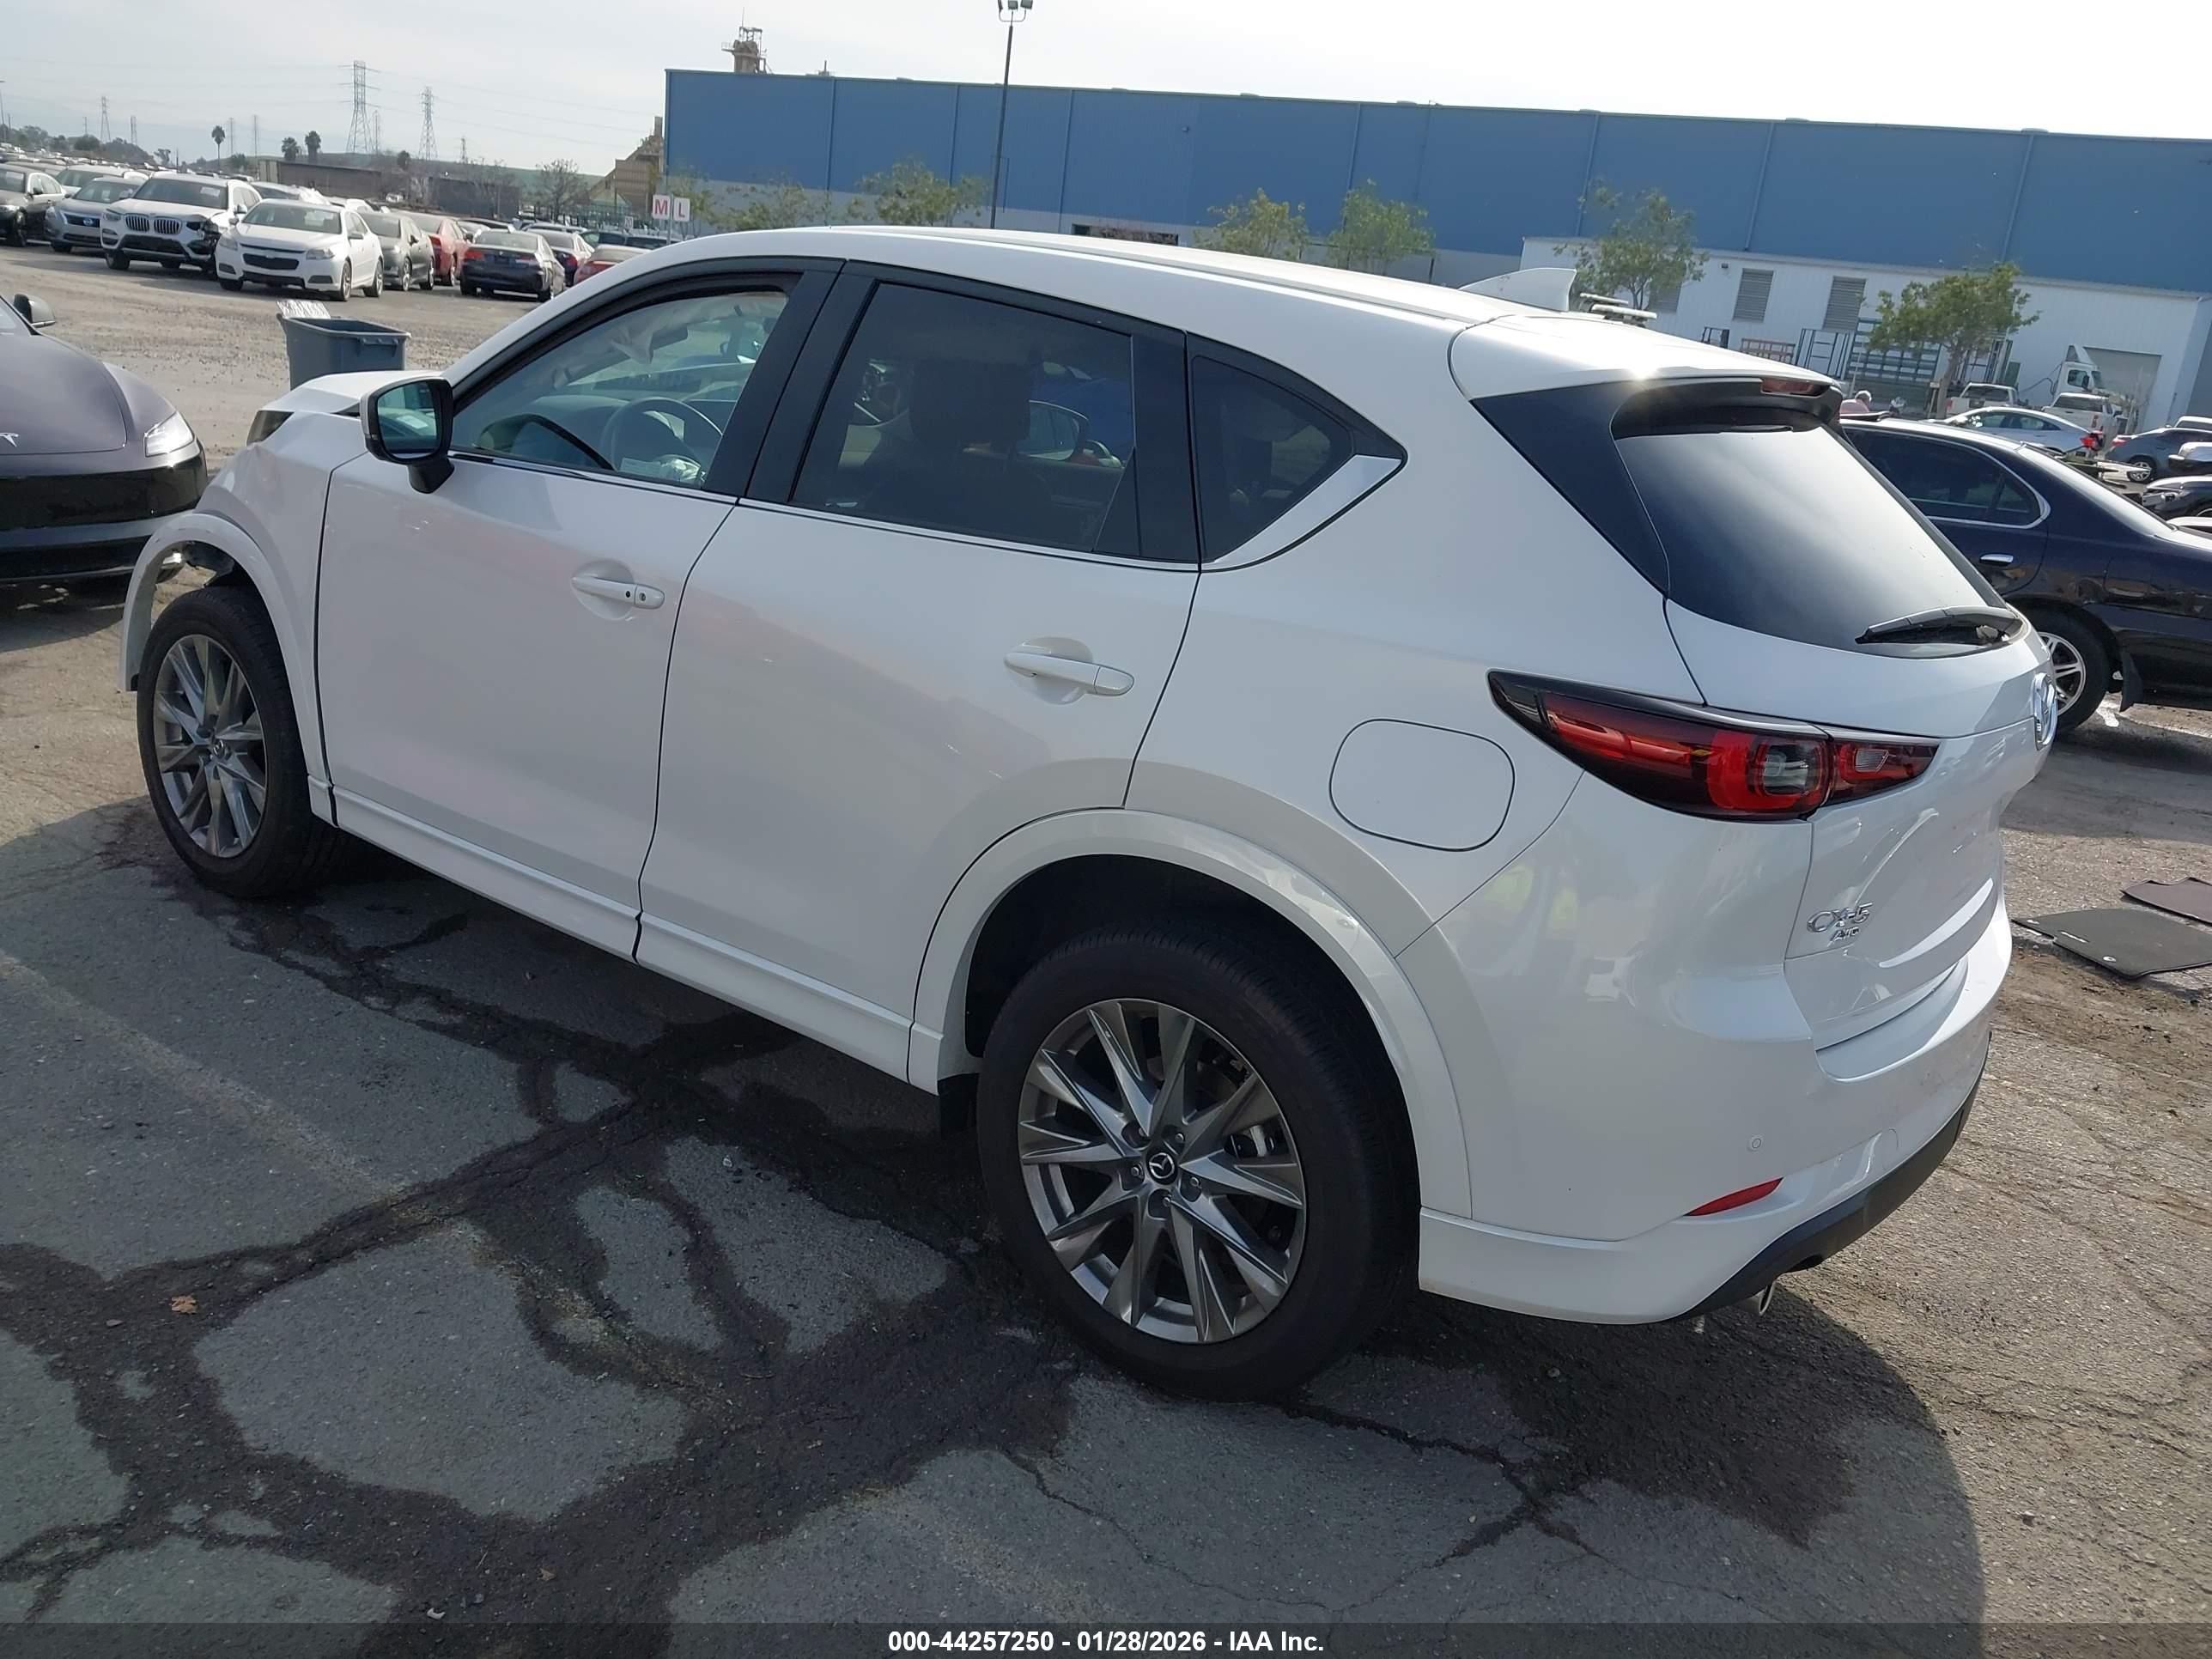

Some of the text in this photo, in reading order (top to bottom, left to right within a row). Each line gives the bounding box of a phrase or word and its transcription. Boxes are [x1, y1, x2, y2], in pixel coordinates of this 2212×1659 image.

[655, 198, 668, 215] M
[678, 201, 685, 218] L
[1807, 902, 1873, 933] CX-5
